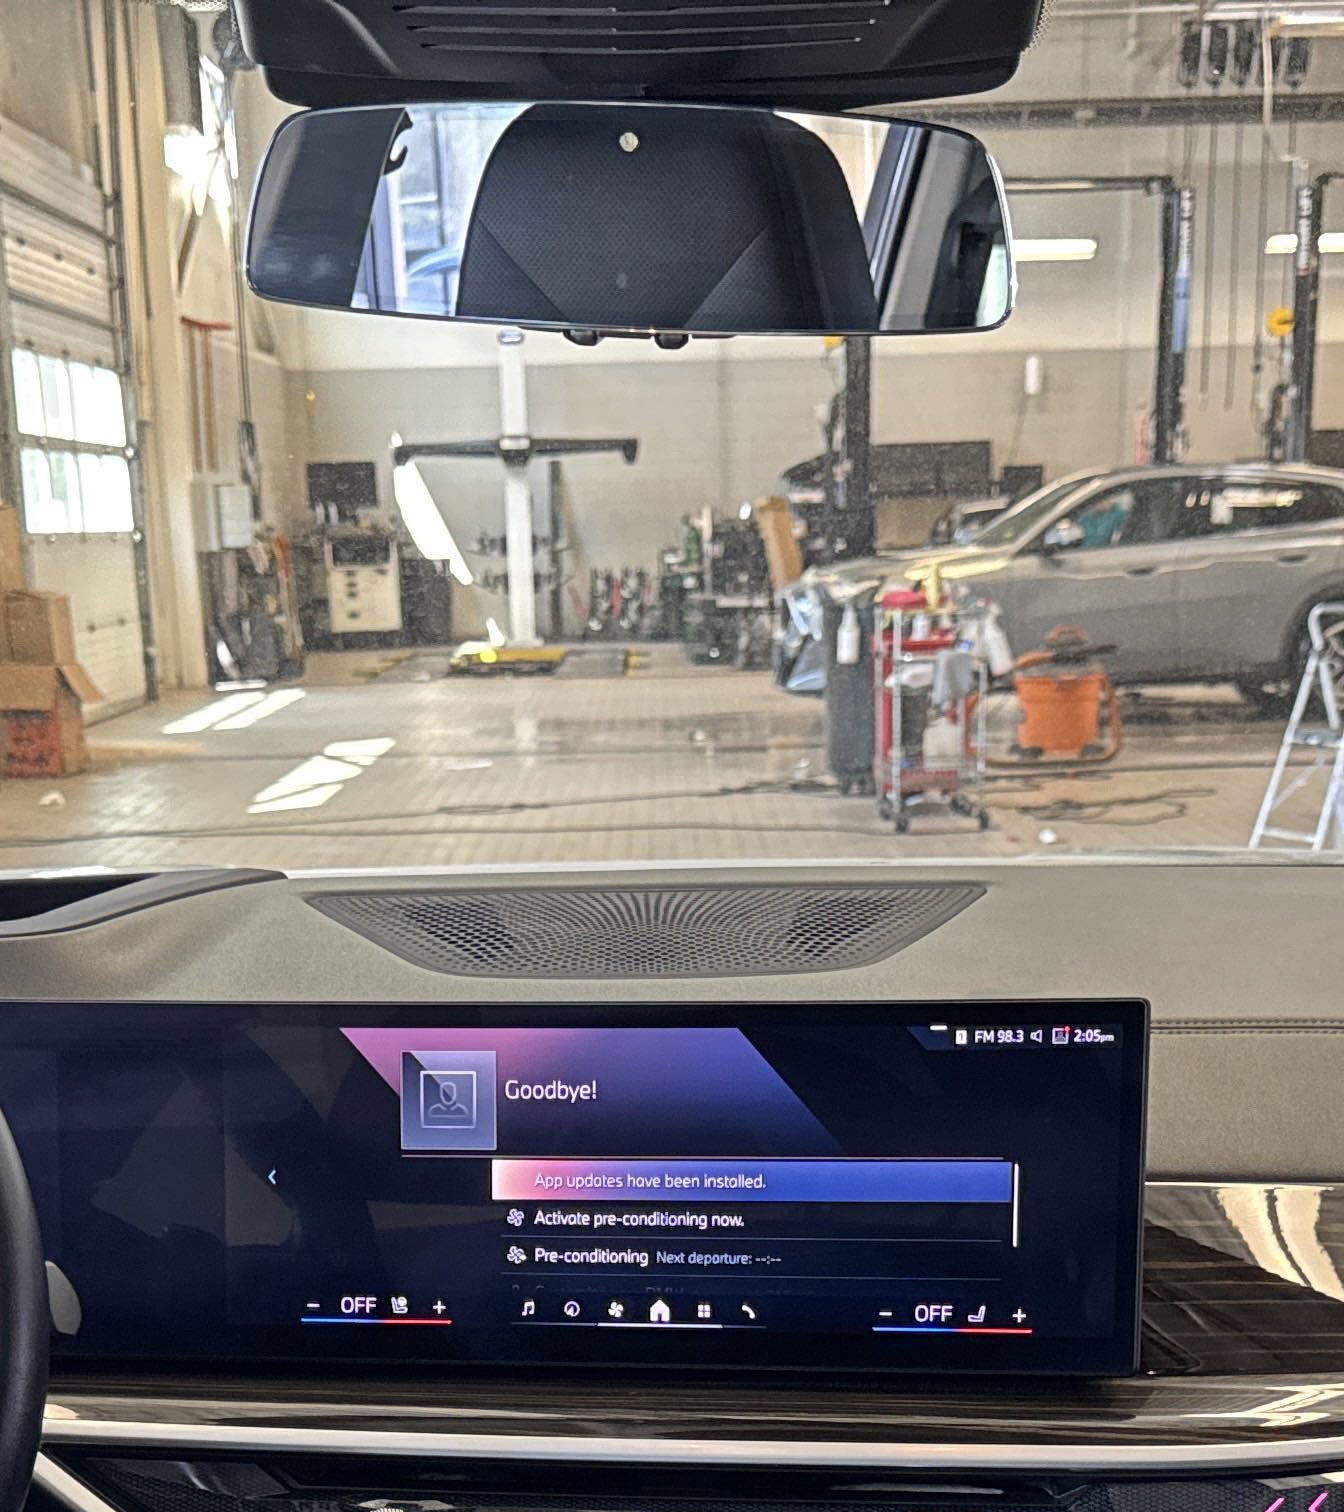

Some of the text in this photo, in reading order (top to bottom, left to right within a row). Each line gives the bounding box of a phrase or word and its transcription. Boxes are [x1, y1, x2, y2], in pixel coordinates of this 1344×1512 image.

[975, 1029, 994, 1043] FM
[997, 1029, 1024, 1043] 98.3
[505, 1080, 597, 1103] Goodbye!
[534, 1173, 767, 1190] App updates have been installed.
[534, 1210, 745, 1229] Activate pre-conditioning now.
[534, 1248, 649, 1267] Pre-conditioning
[656, 1251, 685, 1264] Next
[687, 1251, 753, 1267] departure:
[341, 1297, 376, 1313] OFF
[915, 1305, 953, 1322] OFF
